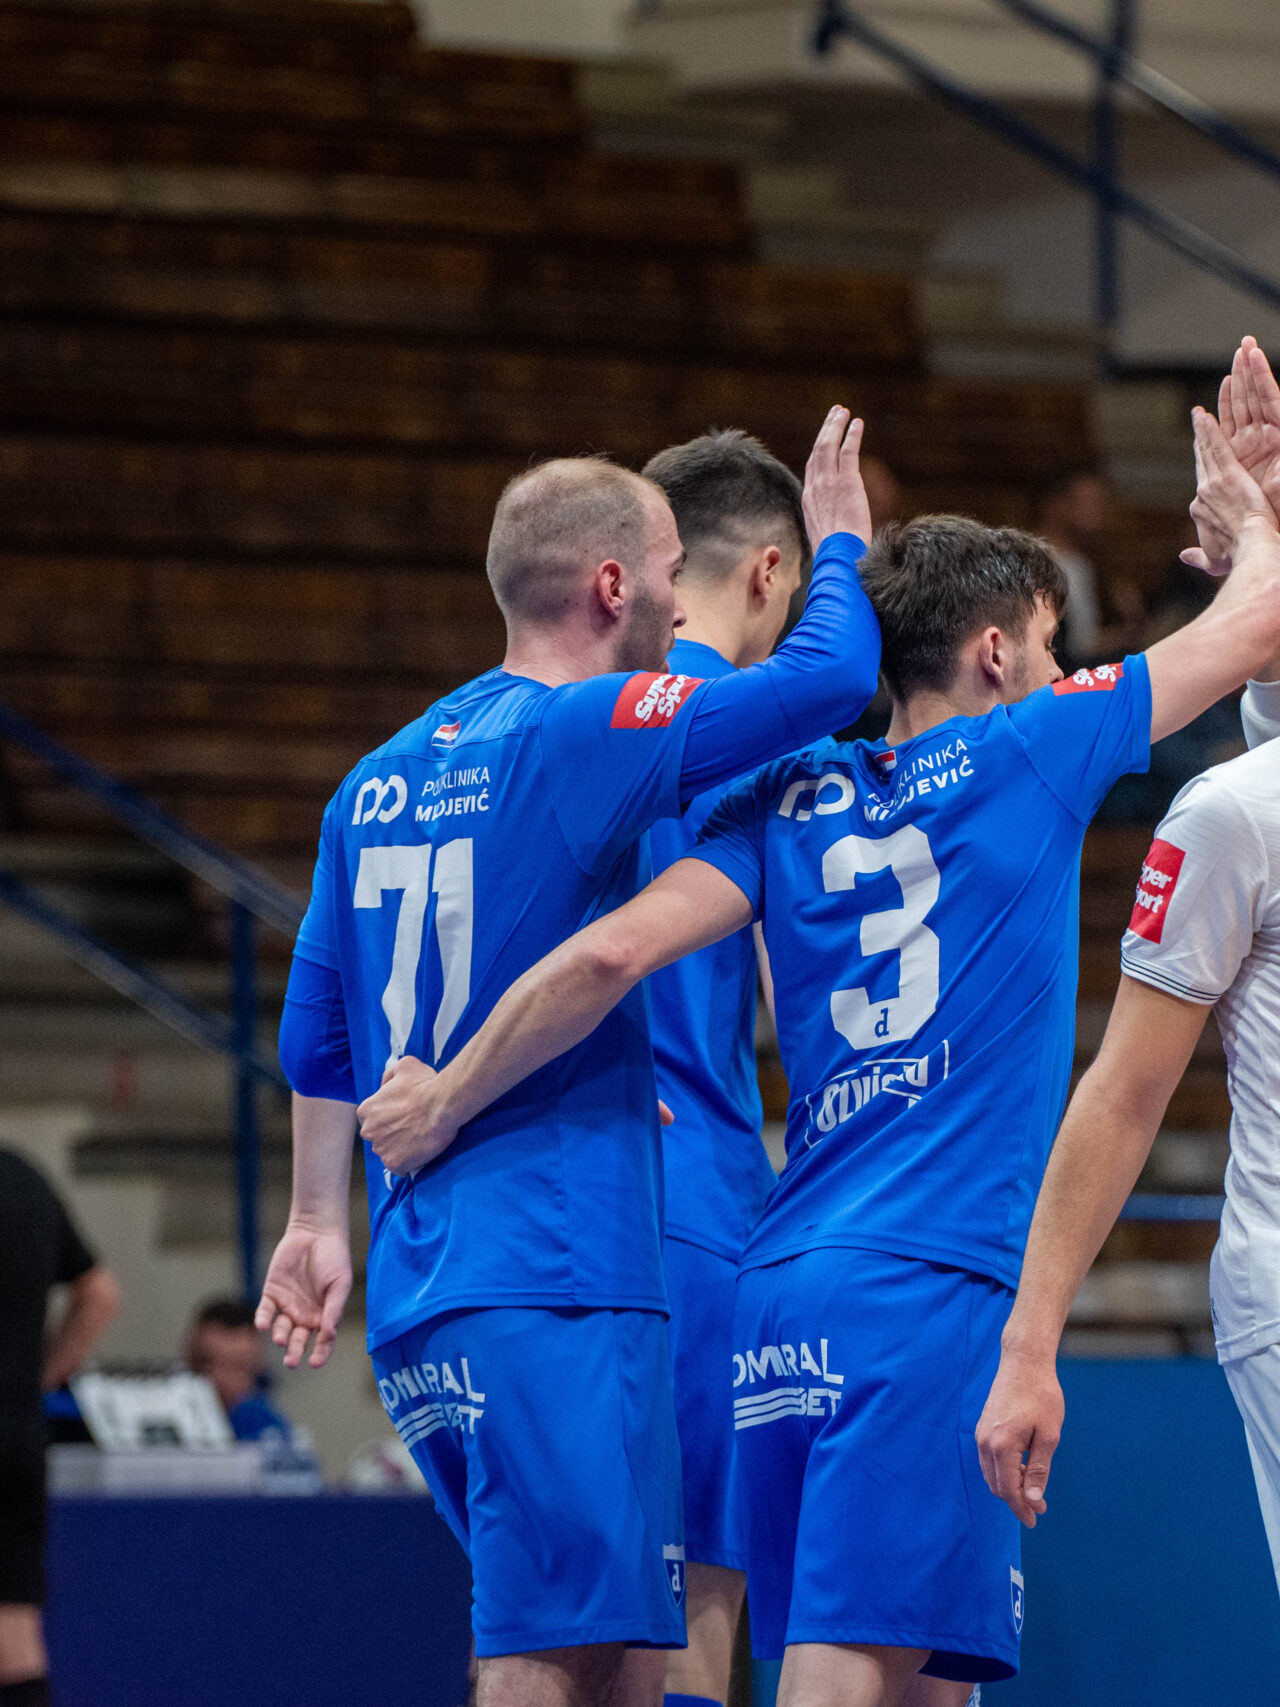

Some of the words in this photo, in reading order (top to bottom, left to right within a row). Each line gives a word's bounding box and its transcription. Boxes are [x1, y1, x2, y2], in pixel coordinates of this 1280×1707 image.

[1142, 861, 1173, 889] per
[352, 837, 474, 1070] 71
[821, 823, 941, 1051] 3
[379, 1357, 486, 1417] DMIRAL
[731, 1338, 845, 1388] DMIRAL
